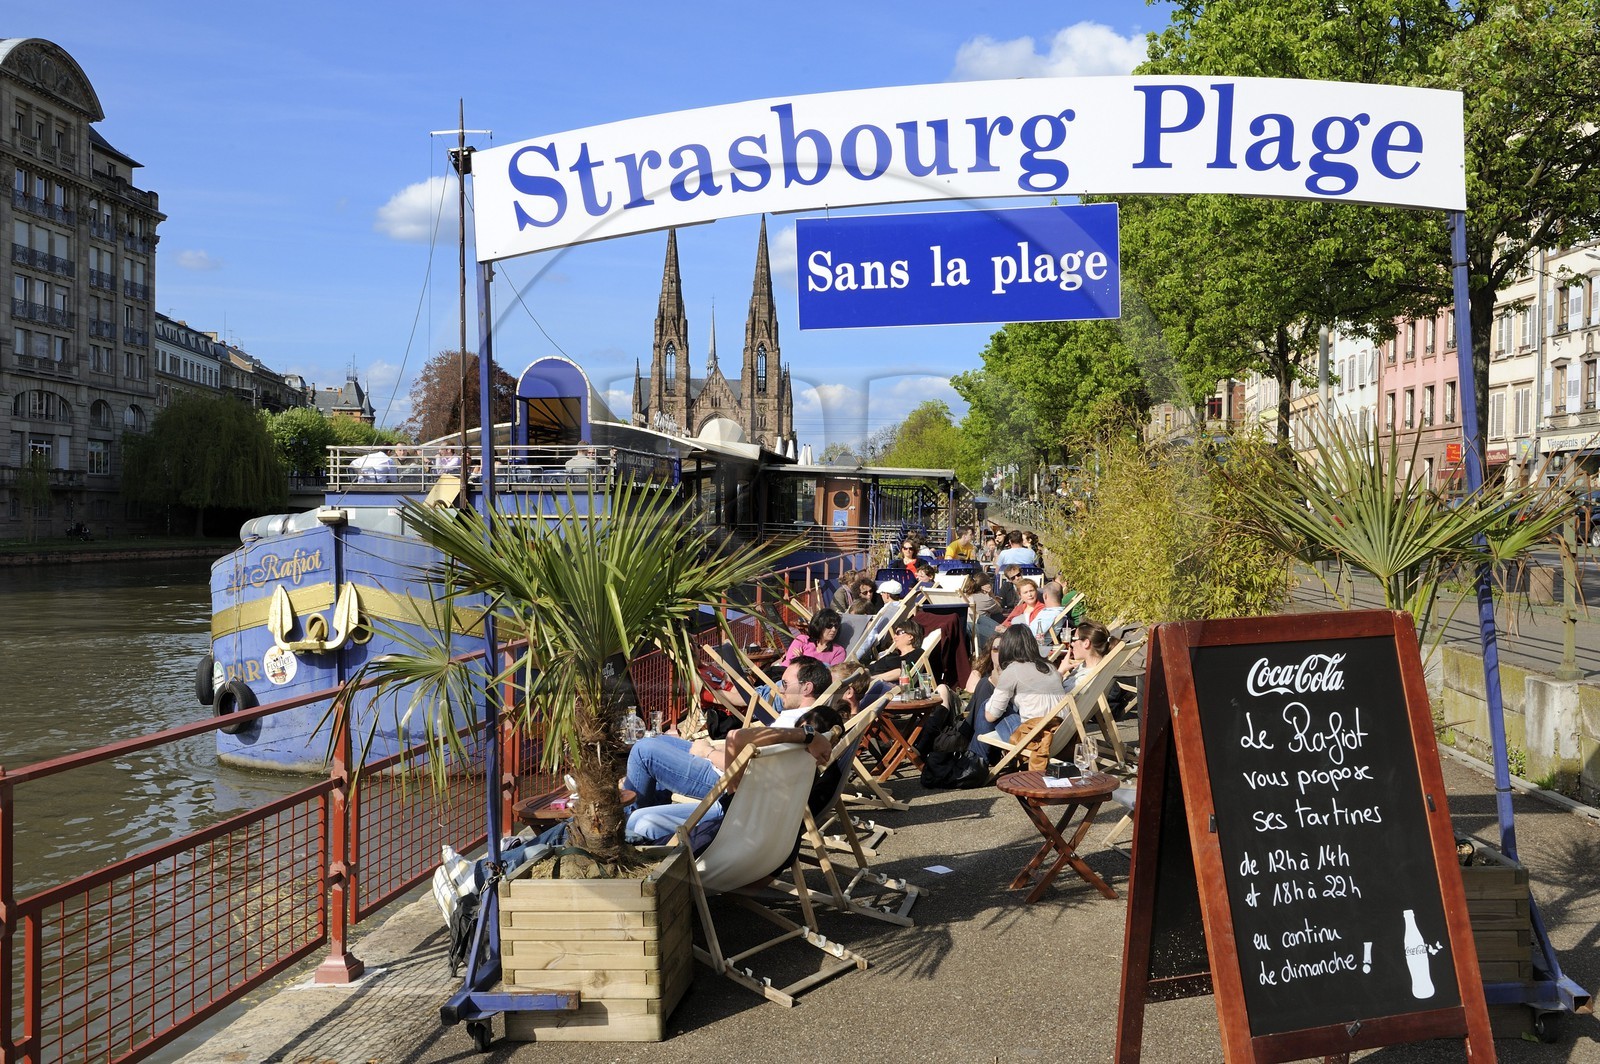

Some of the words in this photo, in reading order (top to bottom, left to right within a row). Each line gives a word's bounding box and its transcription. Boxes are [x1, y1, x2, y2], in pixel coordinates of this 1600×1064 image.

[507, 102, 1075, 231] Strasbourg
[1133, 83, 1424, 196] Plage
[807, 250, 910, 292] Sans
[929, 245, 971, 287] la
[991, 241, 1108, 294] plage
[251, 549, 321, 588] Rafiot
[226, 660, 262, 684] BAR
[1246, 652, 1347, 697] Coca-Cola
[1240, 712, 1274, 750] Le
[1282, 702, 1368, 765] Rafiot
[1242, 770, 1289, 790] vous
[1297, 765, 1374, 795] propose
[1252, 811, 1288, 832] ses
[1295, 797, 1382, 828] tartines
[1239, 851, 1259, 876] de
[1317, 844, 1350, 871] 14h
[1245, 882, 1261, 907] et
